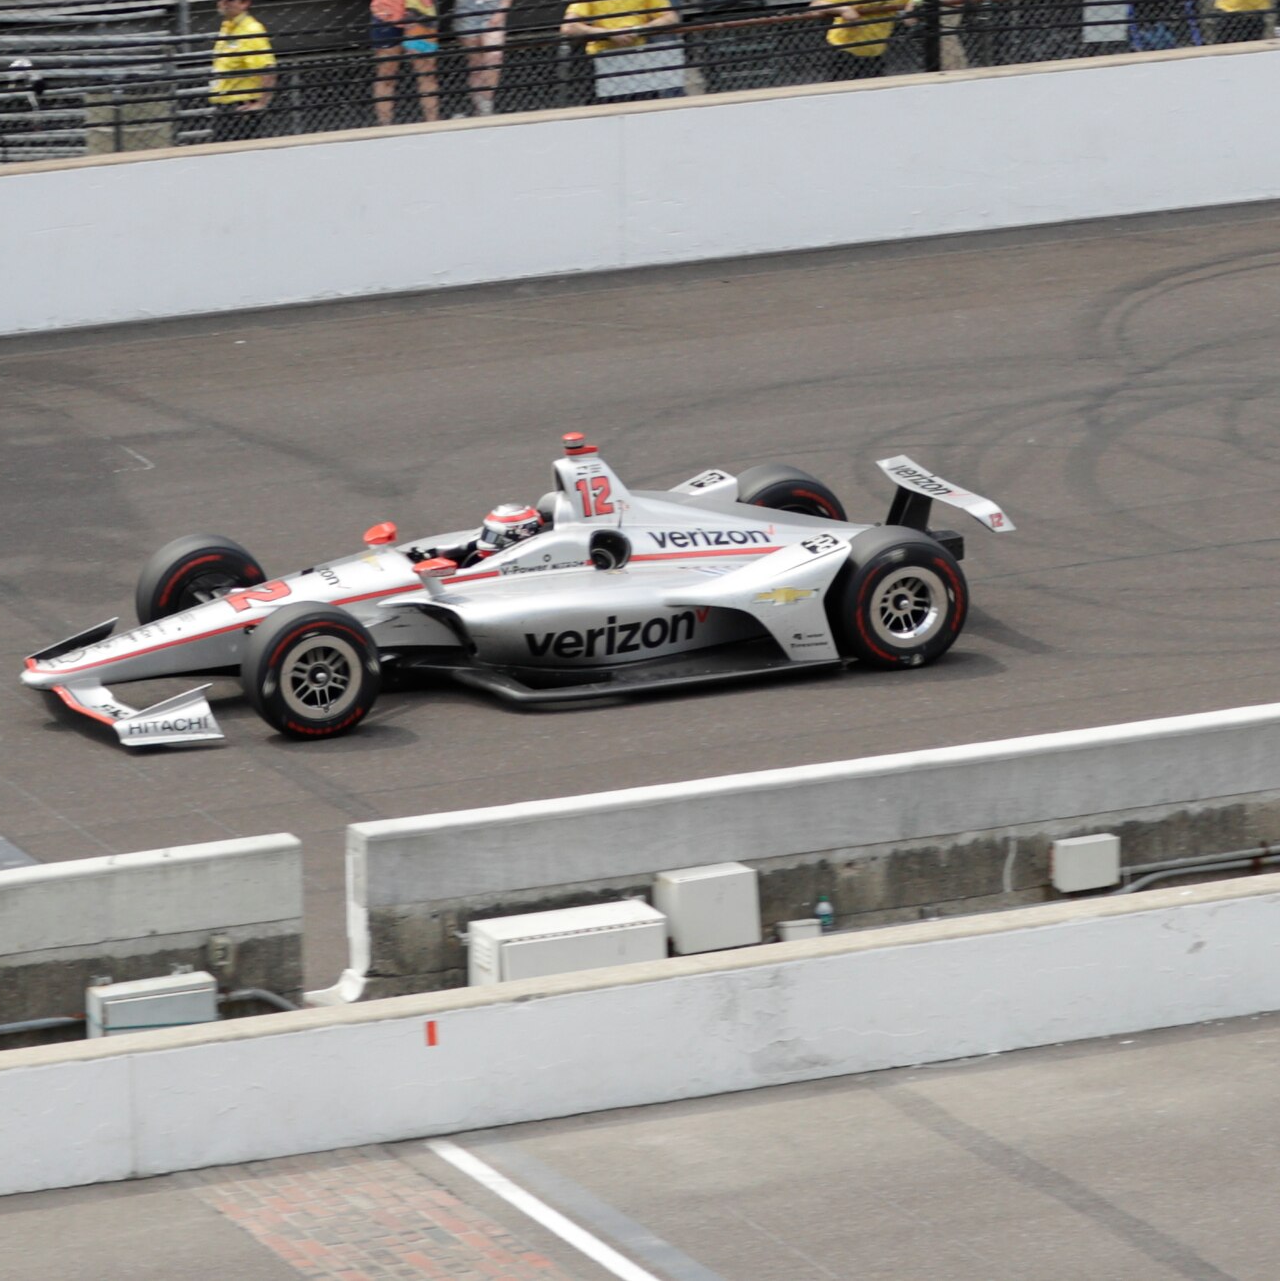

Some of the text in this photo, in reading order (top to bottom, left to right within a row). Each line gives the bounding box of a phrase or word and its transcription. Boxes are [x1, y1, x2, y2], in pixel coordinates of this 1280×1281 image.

[575, 476, 615, 517] 12
[888, 464, 952, 496] verizon
[648, 526, 771, 549] verizon
[223, 579, 292, 613] 2
[524, 610, 696, 659] verizon
[128, 716, 210, 735] HITACHI
